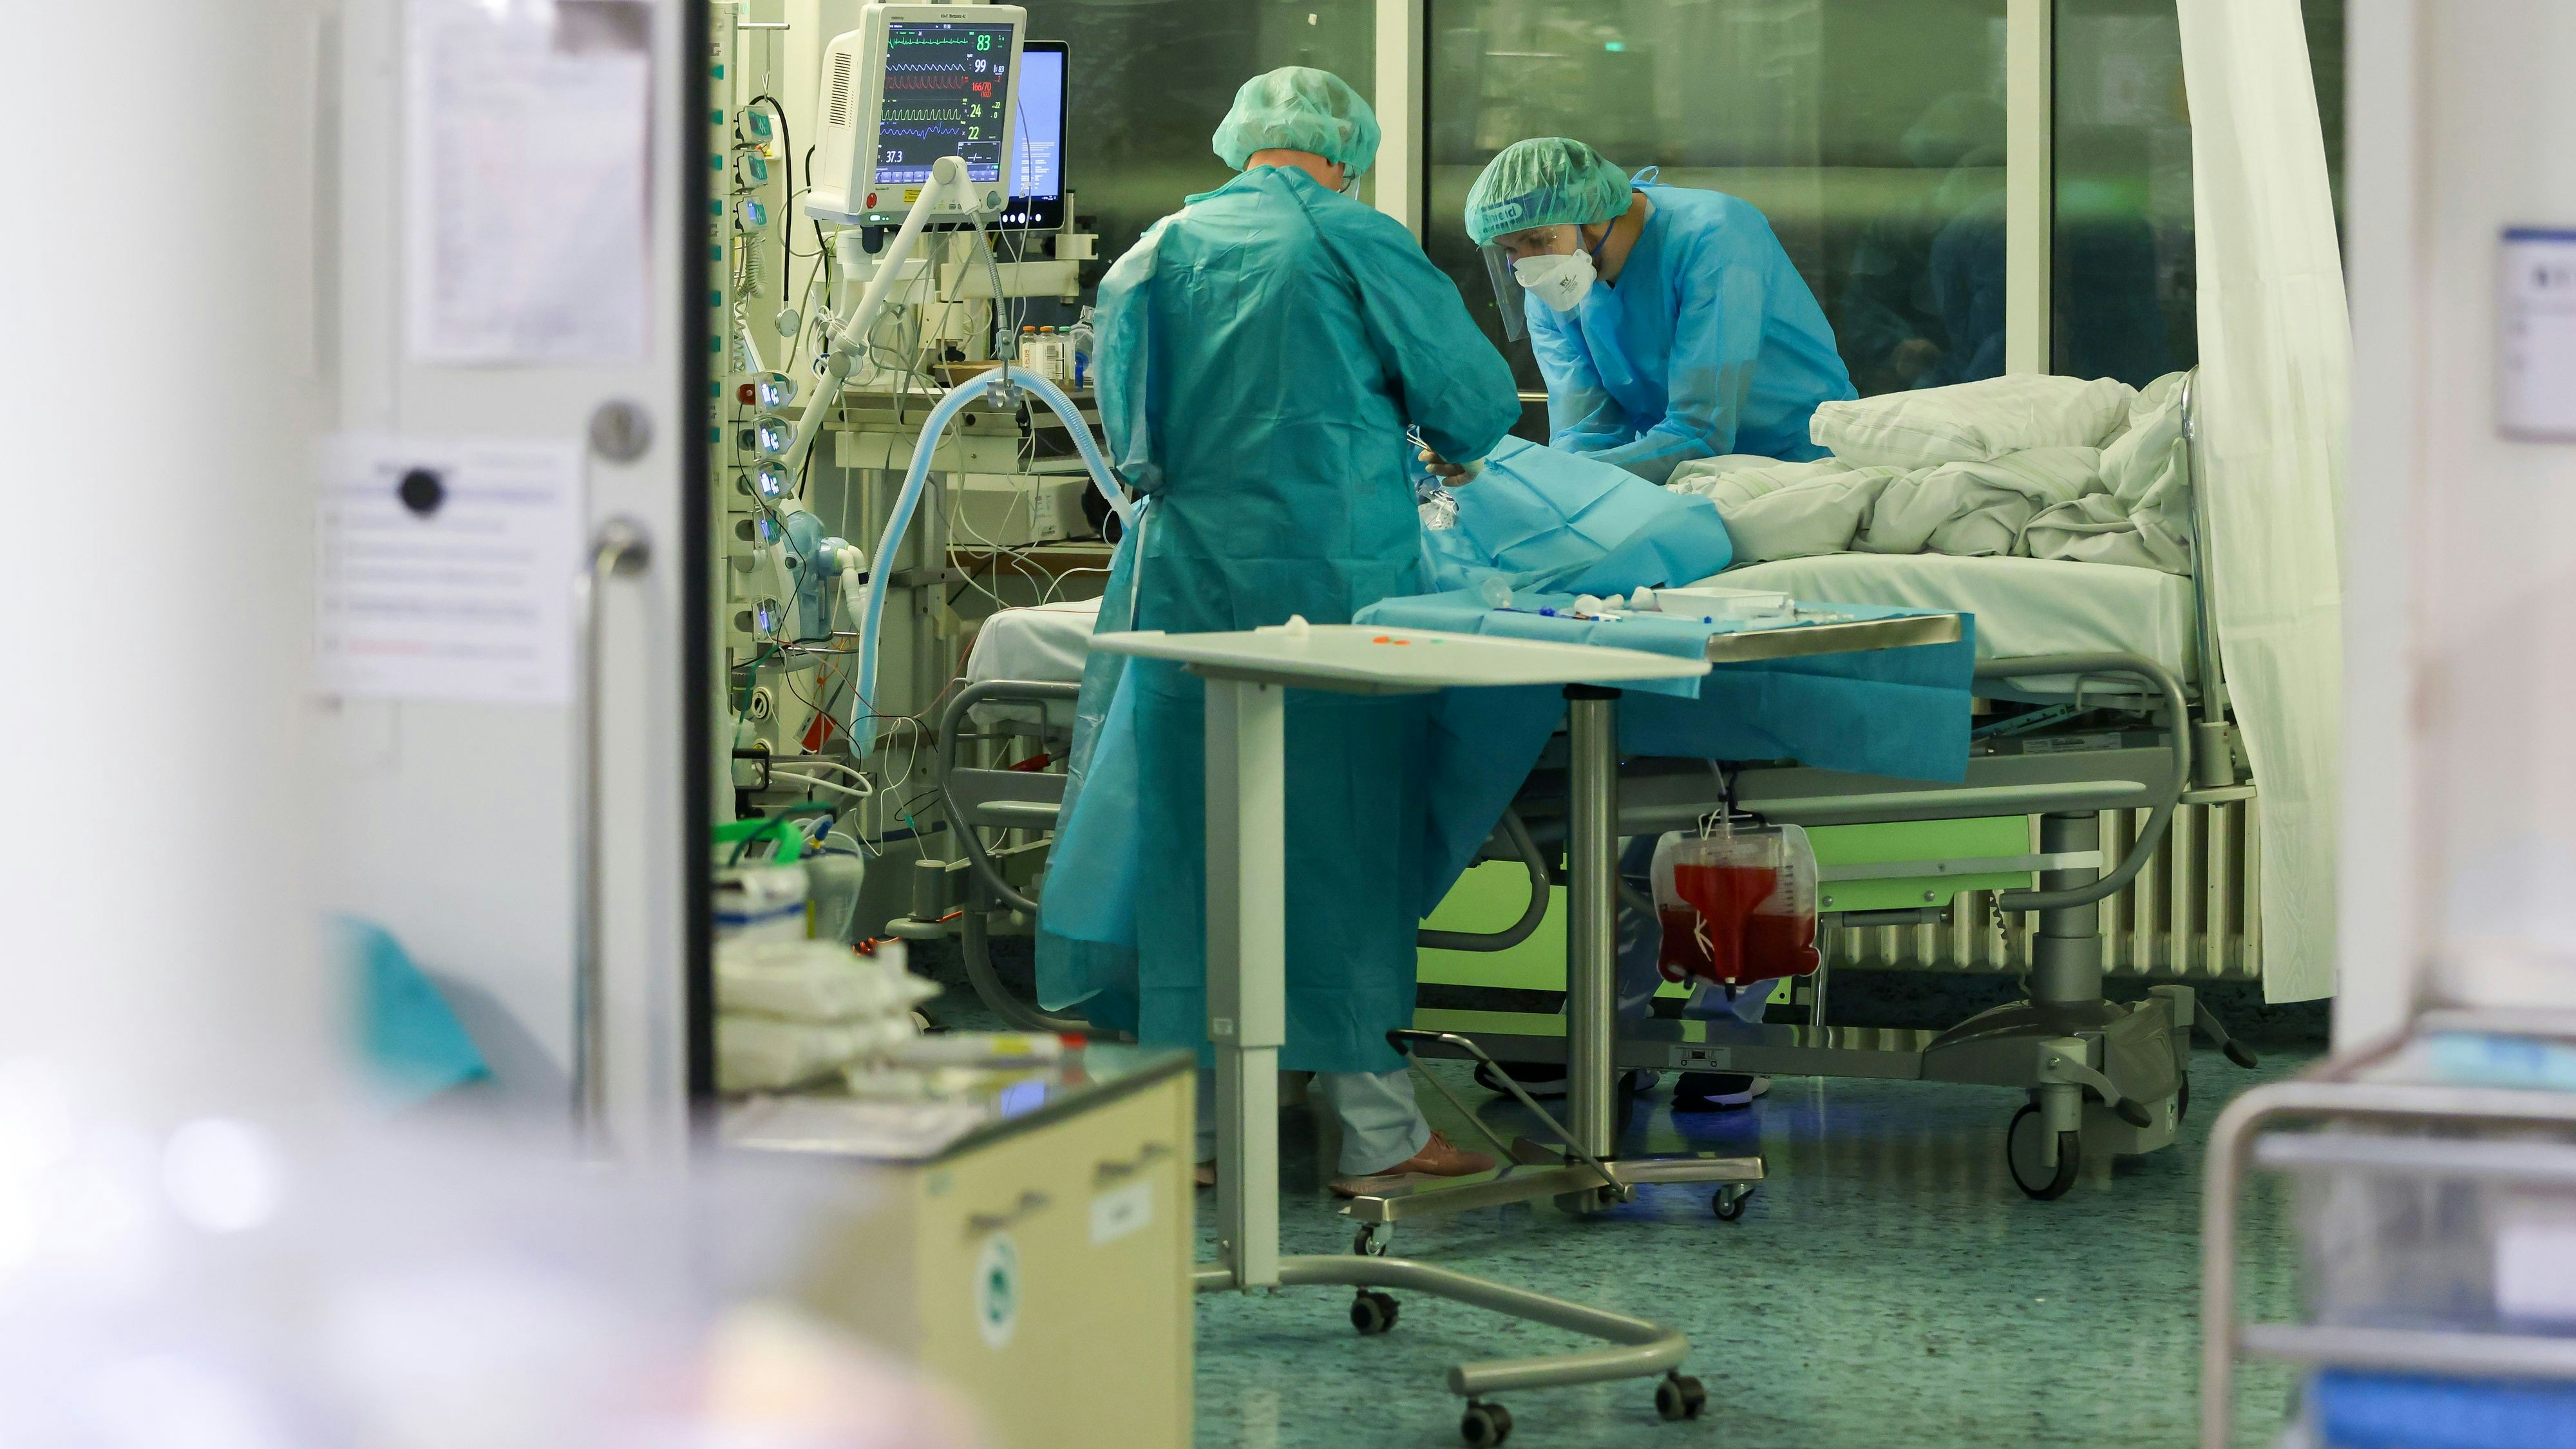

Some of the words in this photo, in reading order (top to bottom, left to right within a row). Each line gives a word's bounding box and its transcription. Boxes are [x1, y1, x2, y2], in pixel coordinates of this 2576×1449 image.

[976, 34, 990, 51] 83
[974, 59, 987, 73] 99
[970, 104, 981, 118] 24
[968, 126, 980, 140] 22
[886, 151, 902, 163] 37.3
